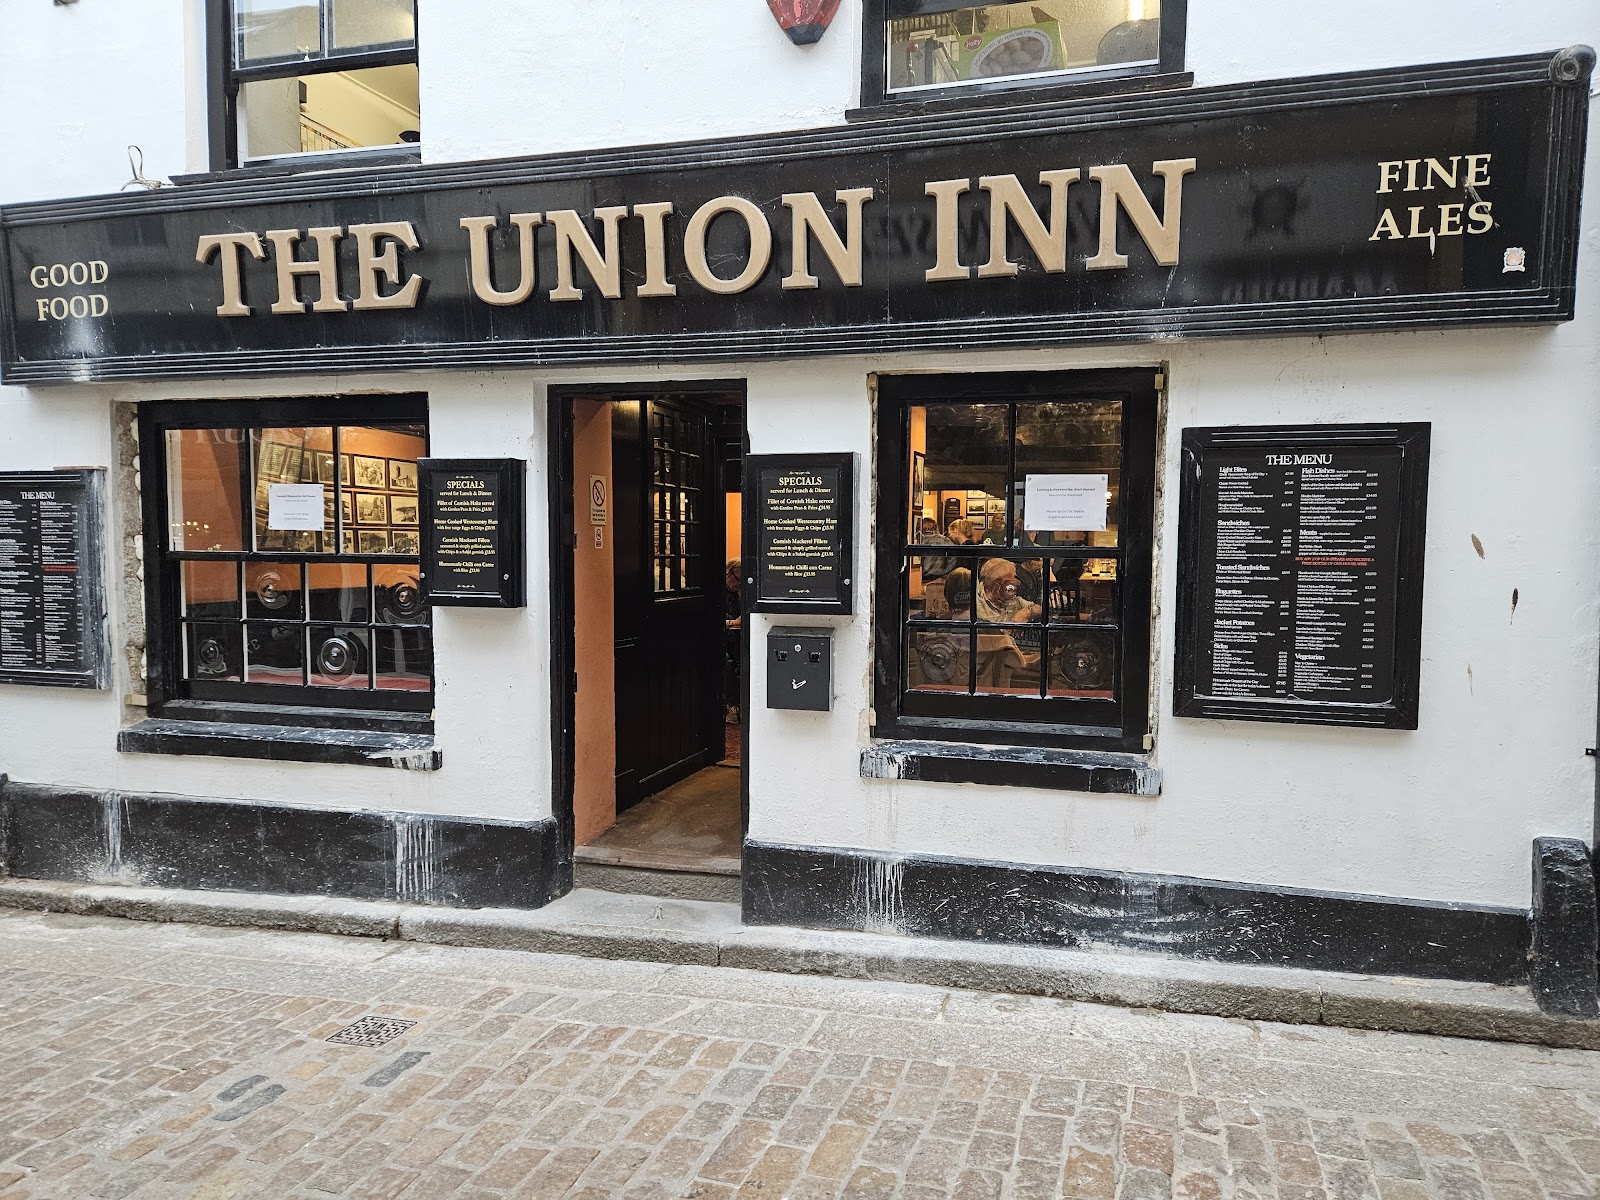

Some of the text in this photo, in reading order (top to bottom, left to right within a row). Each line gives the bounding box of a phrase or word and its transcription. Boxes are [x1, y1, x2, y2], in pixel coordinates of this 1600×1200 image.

[1376, 154, 1492, 194] FINE
[1368, 202, 1494, 241] ALES
[196, 158, 1196, 317] THE UNION INN
[30, 260, 108, 288] GOOD
[36, 294, 108, 321] FOOD
[1266, 454, 1334, 465] THE MENU
[446, 480, 484, 489] SPECIALS
[778, 476, 822, 486] SPECIALS
[20, 492, 55, 500] THE MENU
